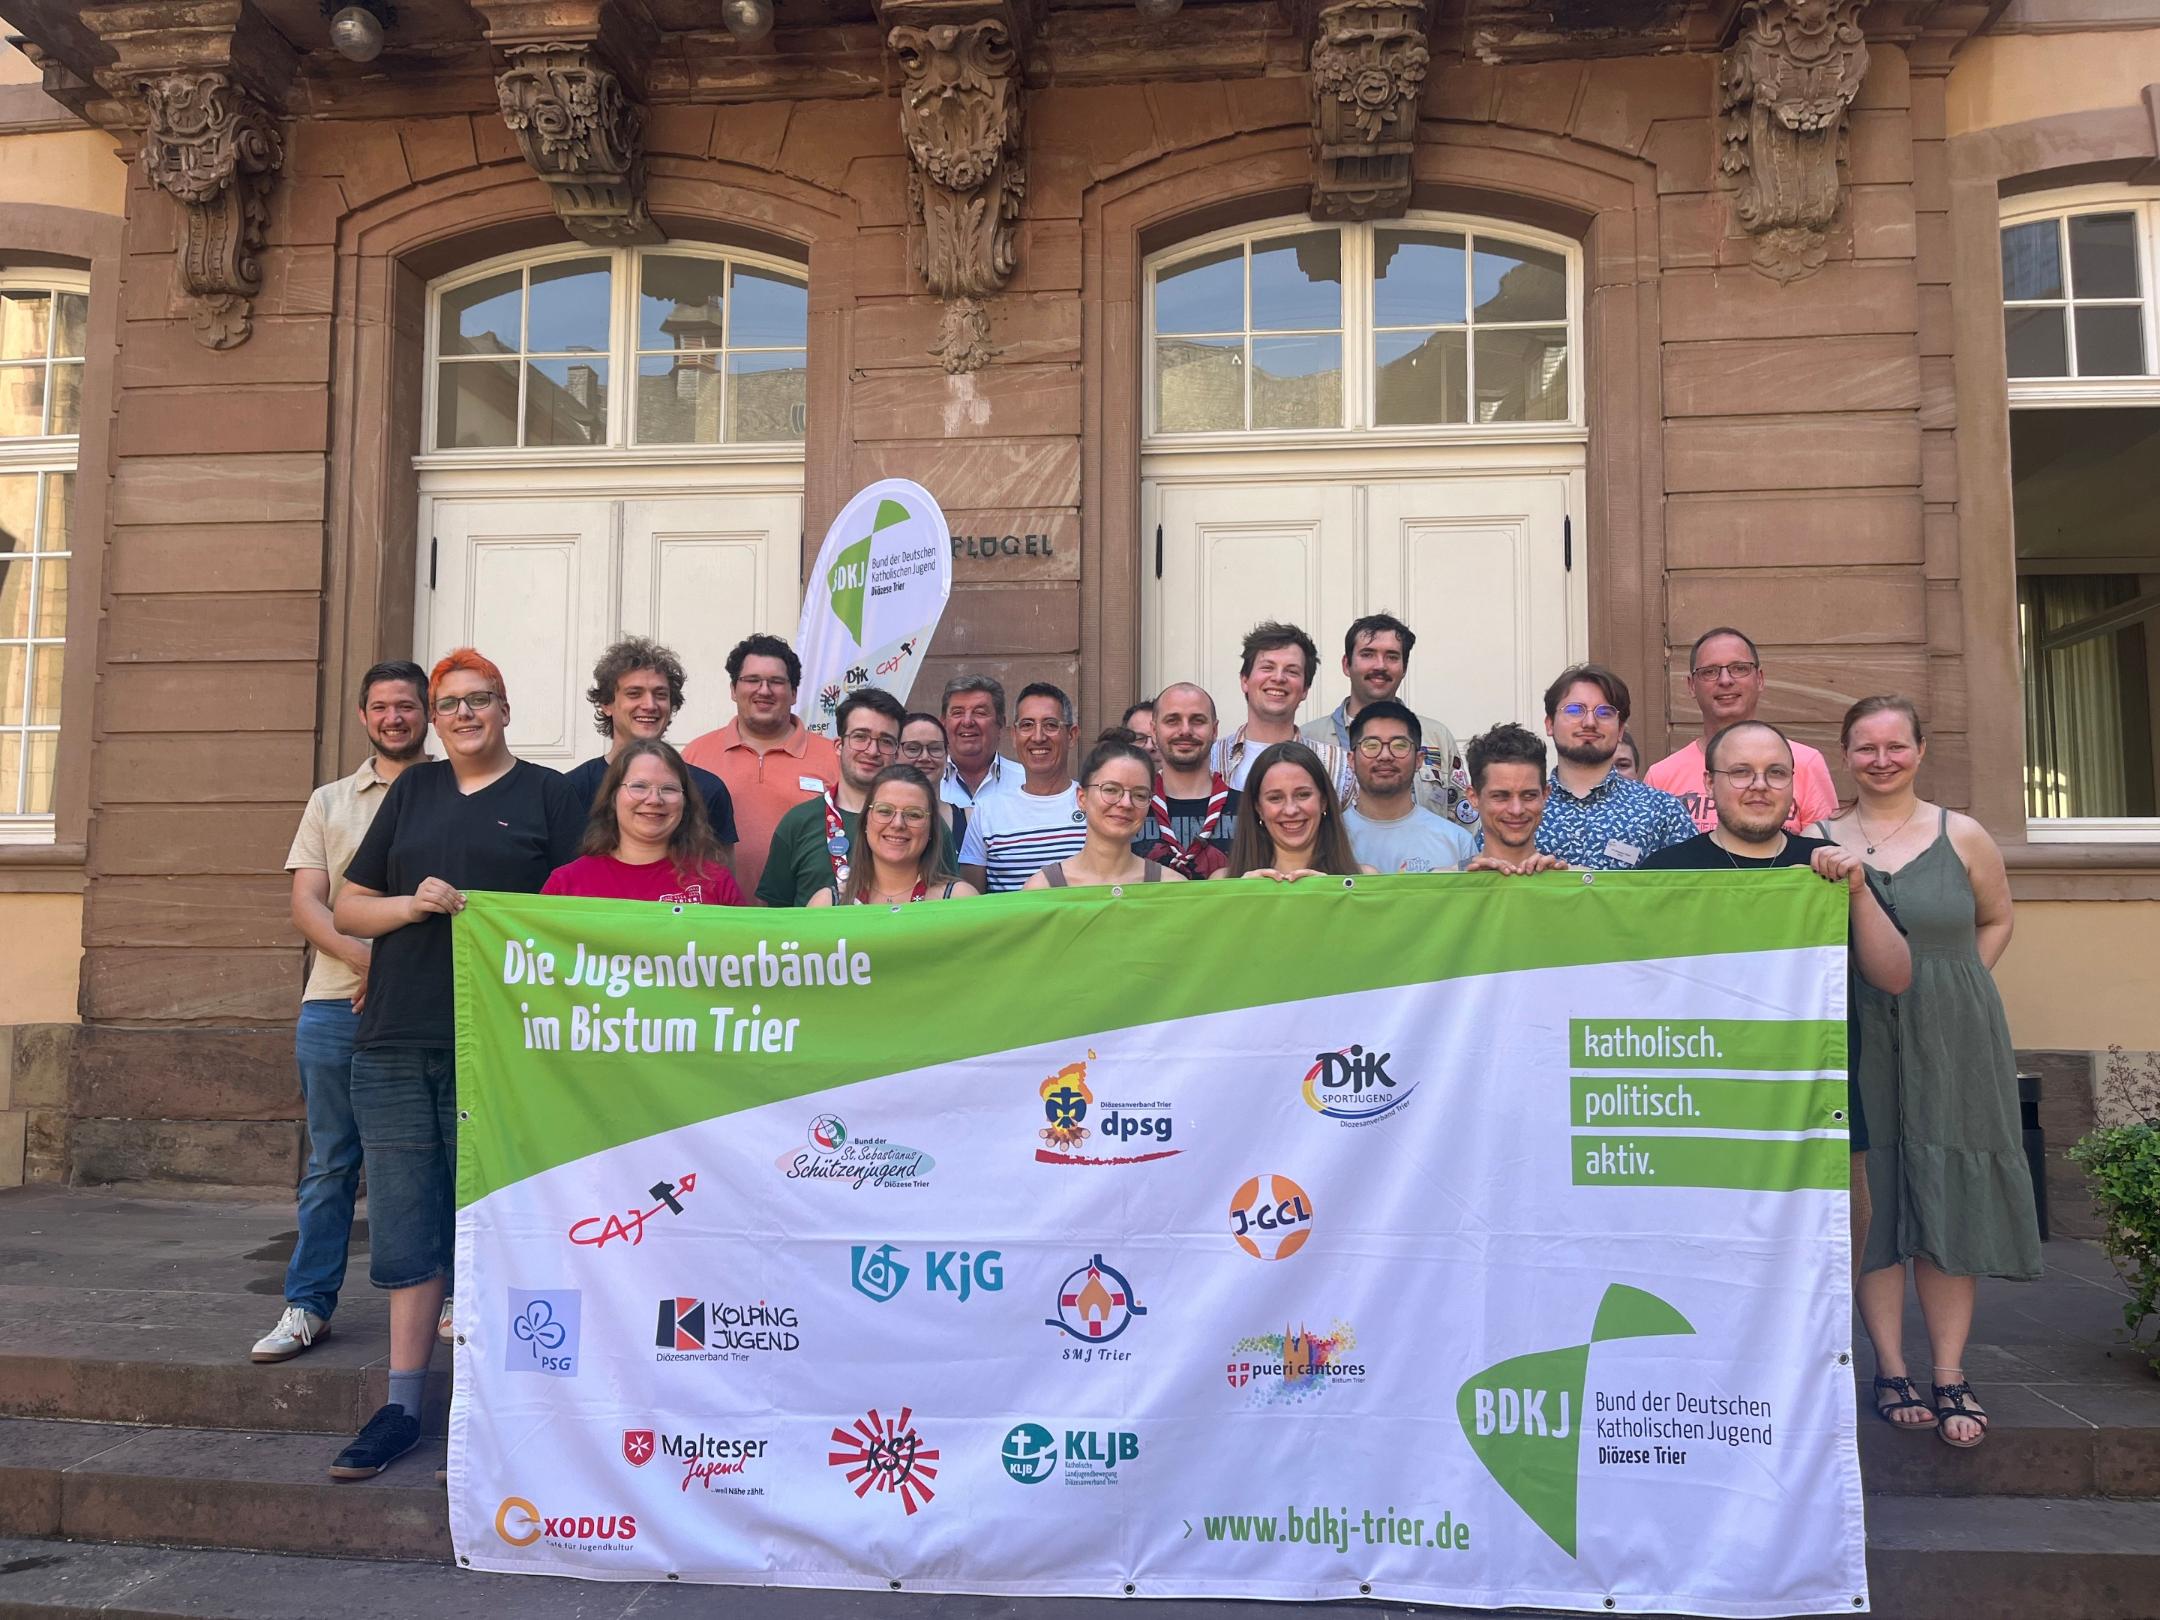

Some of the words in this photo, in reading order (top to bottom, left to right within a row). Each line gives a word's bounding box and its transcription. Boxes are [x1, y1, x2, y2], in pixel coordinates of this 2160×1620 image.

[872, 556, 888, 569] Bund
[889, 554, 901, 565] der
[902, 547, 936, 562] Deutschen
[872, 566, 912, 583] Katholischen
[912, 559, 936, 575] Jugend
[871, 585, 892, 596] Diözese
[893, 582, 905, 592] Trier
[876, 657, 900, 675] CAJ
[503, 938, 555, 986] Die
[564, 938, 872, 998] Jugendverbände
[520, 1002, 560, 1050] im
[570, 1002, 697, 1053] Bistum
[709, 1004, 801, 1053] Trier
[1584, 1025, 1723, 1058] katholisch.
[1322, 1093, 1393, 1103] SPORTJUGEND
[1396, 1100, 1411, 1113] Trier
[1585, 1083, 1700, 1123] politisch.
[1101, 1111, 1172, 1142] dpsg
[841, 1146, 856, 1161] St.
[858, 1146, 917, 1161] Sebastianus
[1586, 1142, 1655, 1175] aktiv.
[787, 1154, 923, 1190] Schützenjugend
[884, 1180, 912, 1188] Diözese
[913, 1180, 930, 1188] Trier
[569, 1209, 644, 1248] CAJ
[1232, 1196, 1310, 1236] J-GCL
[926, 1250, 1004, 1303] KjG
[711, 1330, 799, 1351] JUGEND
[541, 1357, 572, 1371] PSG
[656, 1352, 729, 1362] Diözesanverband
[731, 1352, 750, 1362] Trier
[1062, 1348, 1093, 1363] SMJ
[1097, 1348, 1132, 1362] Trier
[1252, 1361, 1293, 1379] pueri
[1297, 1361, 1366, 1376] cantores
[1475, 1388, 1570, 1438] BDKJ
[1596, 1390, 1636, 1412] Bund
[1642, 1391, 1670, 1412] der
[1676, 1392, 1771, 1418] Deutschen
[1597, 1417, 1703, 1440] Katholischen
[1707, 1420, 1772, 1446] Jugend
[661, 1433, 768, 1458] Malteser
[1065, 1430, 1139, 1469] KLJB
[1599, 1446, 1650, 1464] Diözese
[1653, 1447, 1687, 1465] Trier
[682, 1452, 748, 1492] Jugend
[866, 1434, 916, 1485] KSJ
[1010, 1463, 1033, 1477] KLJB
[728, 1487, 746, 1495] Nähe
[746, 1487, 765, 1496] zählt.
[1203, 1505, 1470, 1554] www.bdkj-trier.de
[579, 1543, 634, 1552] Jugendkultur
